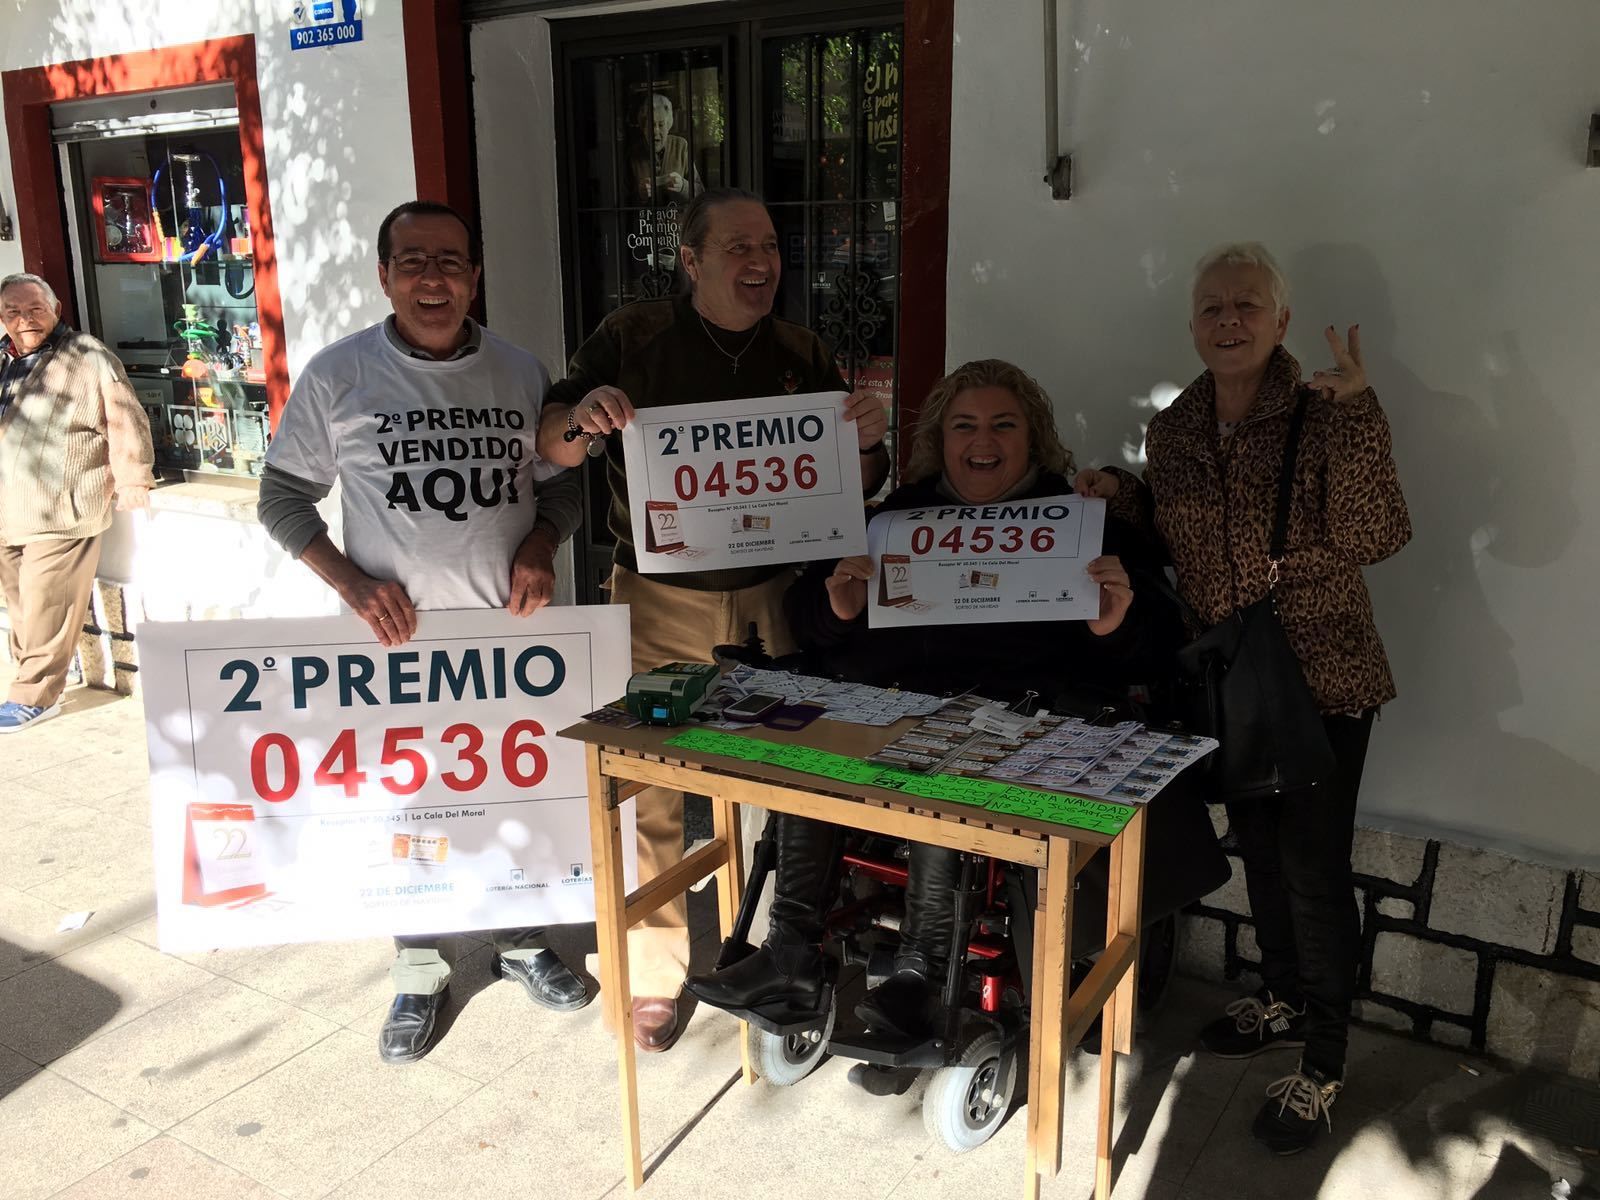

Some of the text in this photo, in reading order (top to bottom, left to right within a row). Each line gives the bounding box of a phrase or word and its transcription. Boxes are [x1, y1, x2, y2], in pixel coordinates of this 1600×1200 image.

[297, 25, 355, 45] 902 365 000
[406, 407, 525, 431] PREMIO
[691, 414, 824, 453] PREMIO
[377, 437, 523, 466] VENDIDO
[674, 453, 818, 501] 04536
[657, 513, 677, 530] 22
[937, 505, 1070, 520] PREMIO
[911, 525, 1056, 555] 04536
[891, 566, 908, 583] 22
[291, 644, 566, 709] PREMIO
[250, 719, 548, 803] 04536
[424, 811, 443, 819] Cala
[446, 810, 459, 818] Del
[461, 808, 486, 817] Moral
[999, 793, 1124, 823] AQUI JUGAMOS
[1005, 786, 1129, 816] EXTRA NAVIDAD
[212, 827, 252, 860] 22
[359, 882, 455, 898] 22 DE DICIEMBRE
[514, 882, 549, 890] NACIONAL
